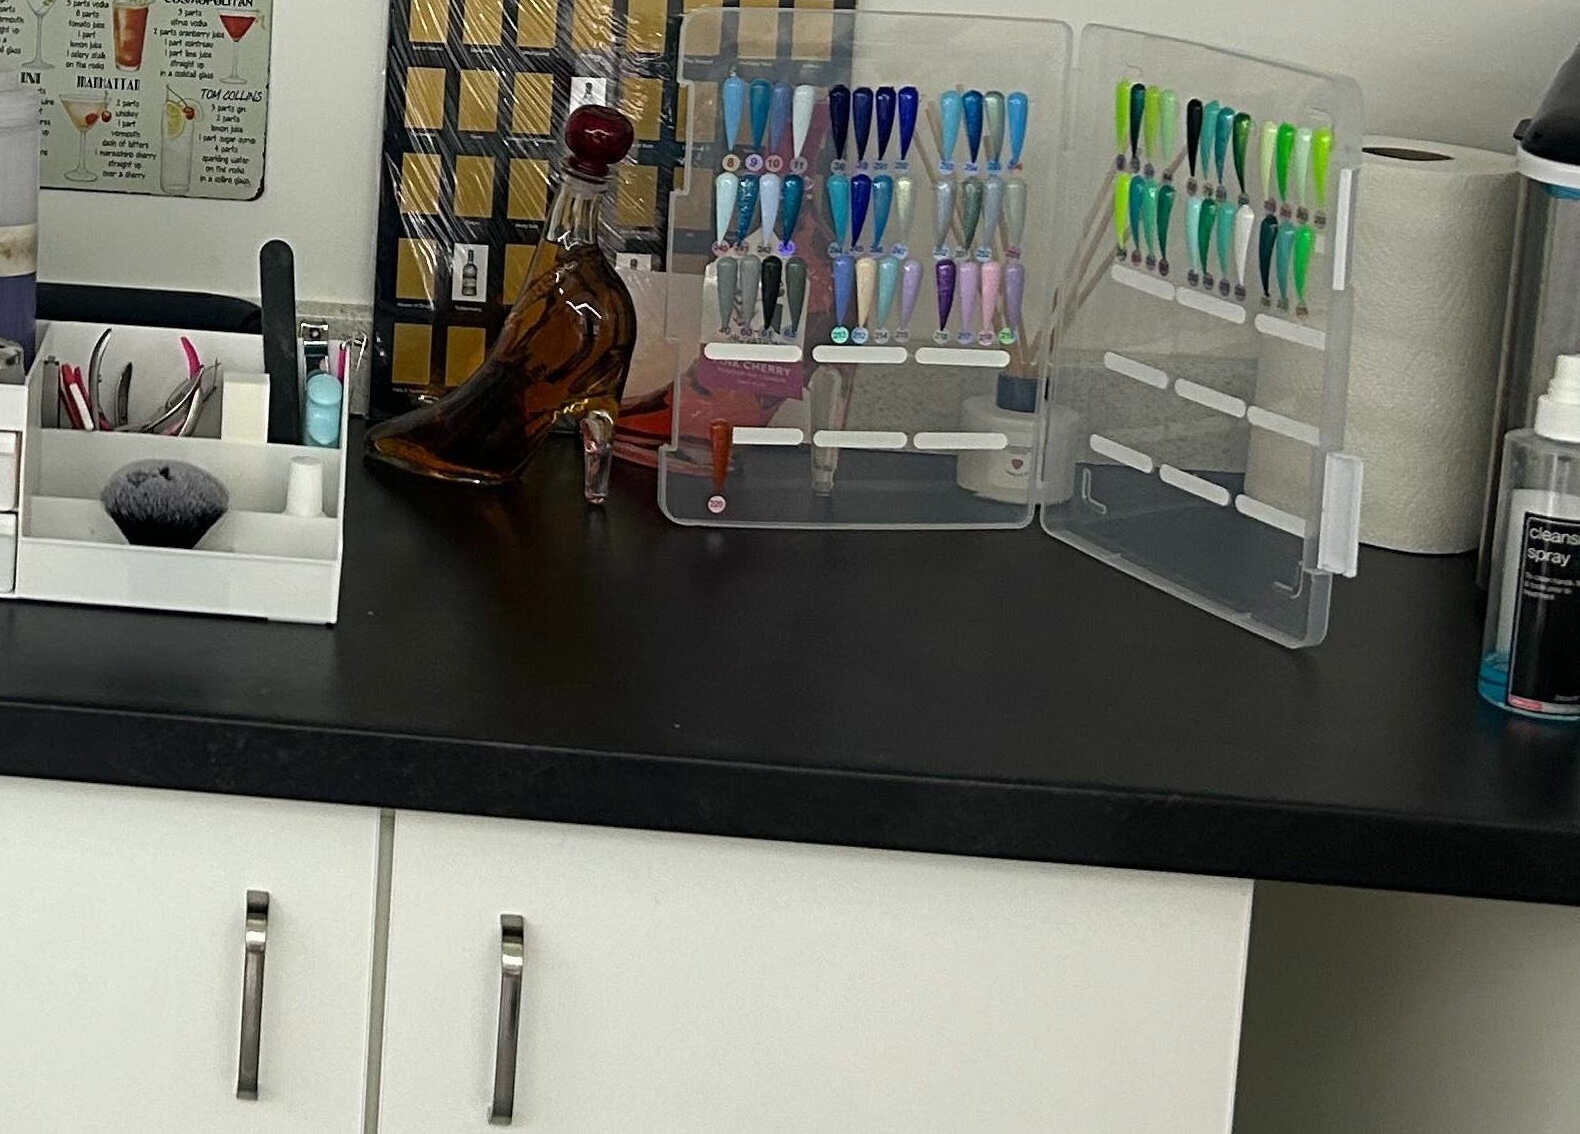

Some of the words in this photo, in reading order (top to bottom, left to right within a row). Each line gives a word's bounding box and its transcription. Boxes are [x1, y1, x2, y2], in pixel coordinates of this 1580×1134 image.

[201, 88, 222, 100] TOM
[743, 361, 791, 376] CHERRY
[1527, 546, 1571, 566] spray
